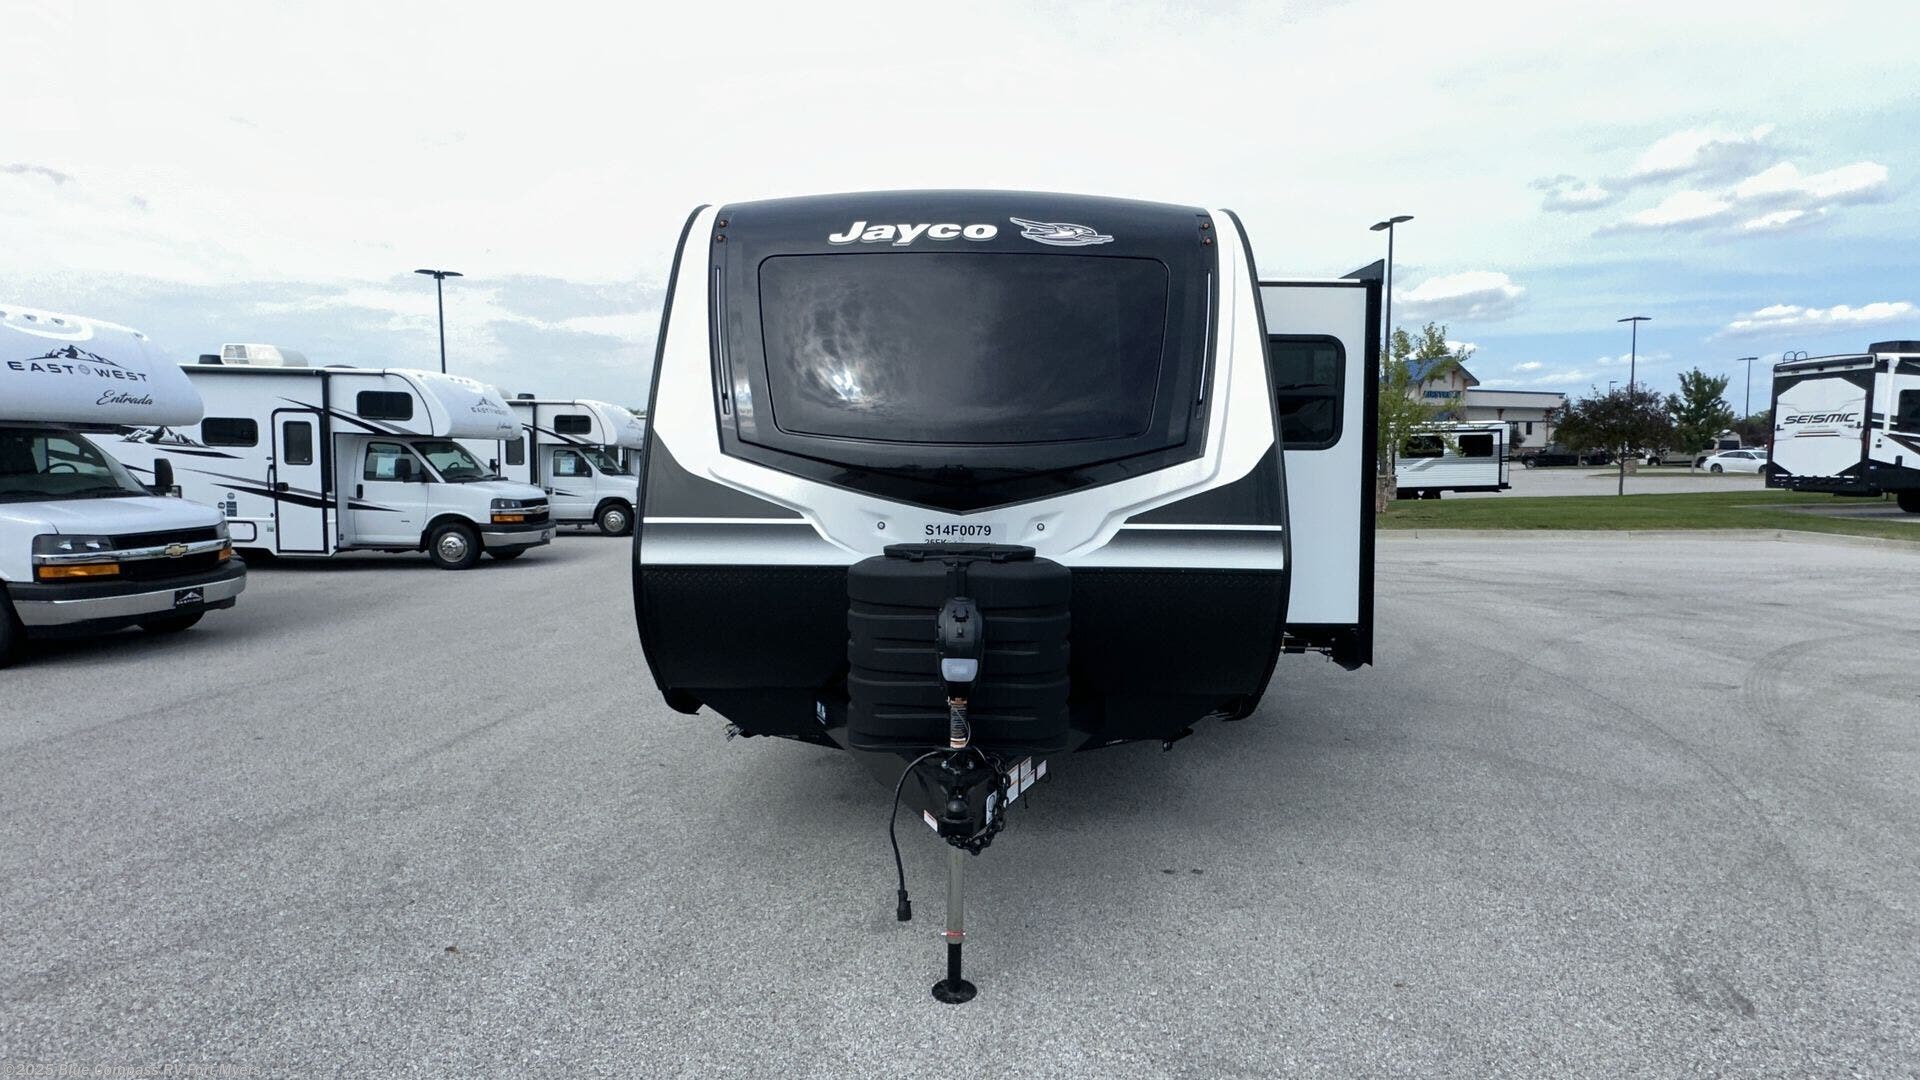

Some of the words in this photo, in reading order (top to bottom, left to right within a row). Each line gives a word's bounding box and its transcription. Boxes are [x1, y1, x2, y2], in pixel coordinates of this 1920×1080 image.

[828, 220, 998, 246] Jayco
[7, 361, 74, 374] EAST
[93, 367, 147, 382] WEST
[96, 389, 154, 406] Entrada
[1783, 412, 1859, 425] SEISMIC
[925, 524, 992, 536] S14F0079
